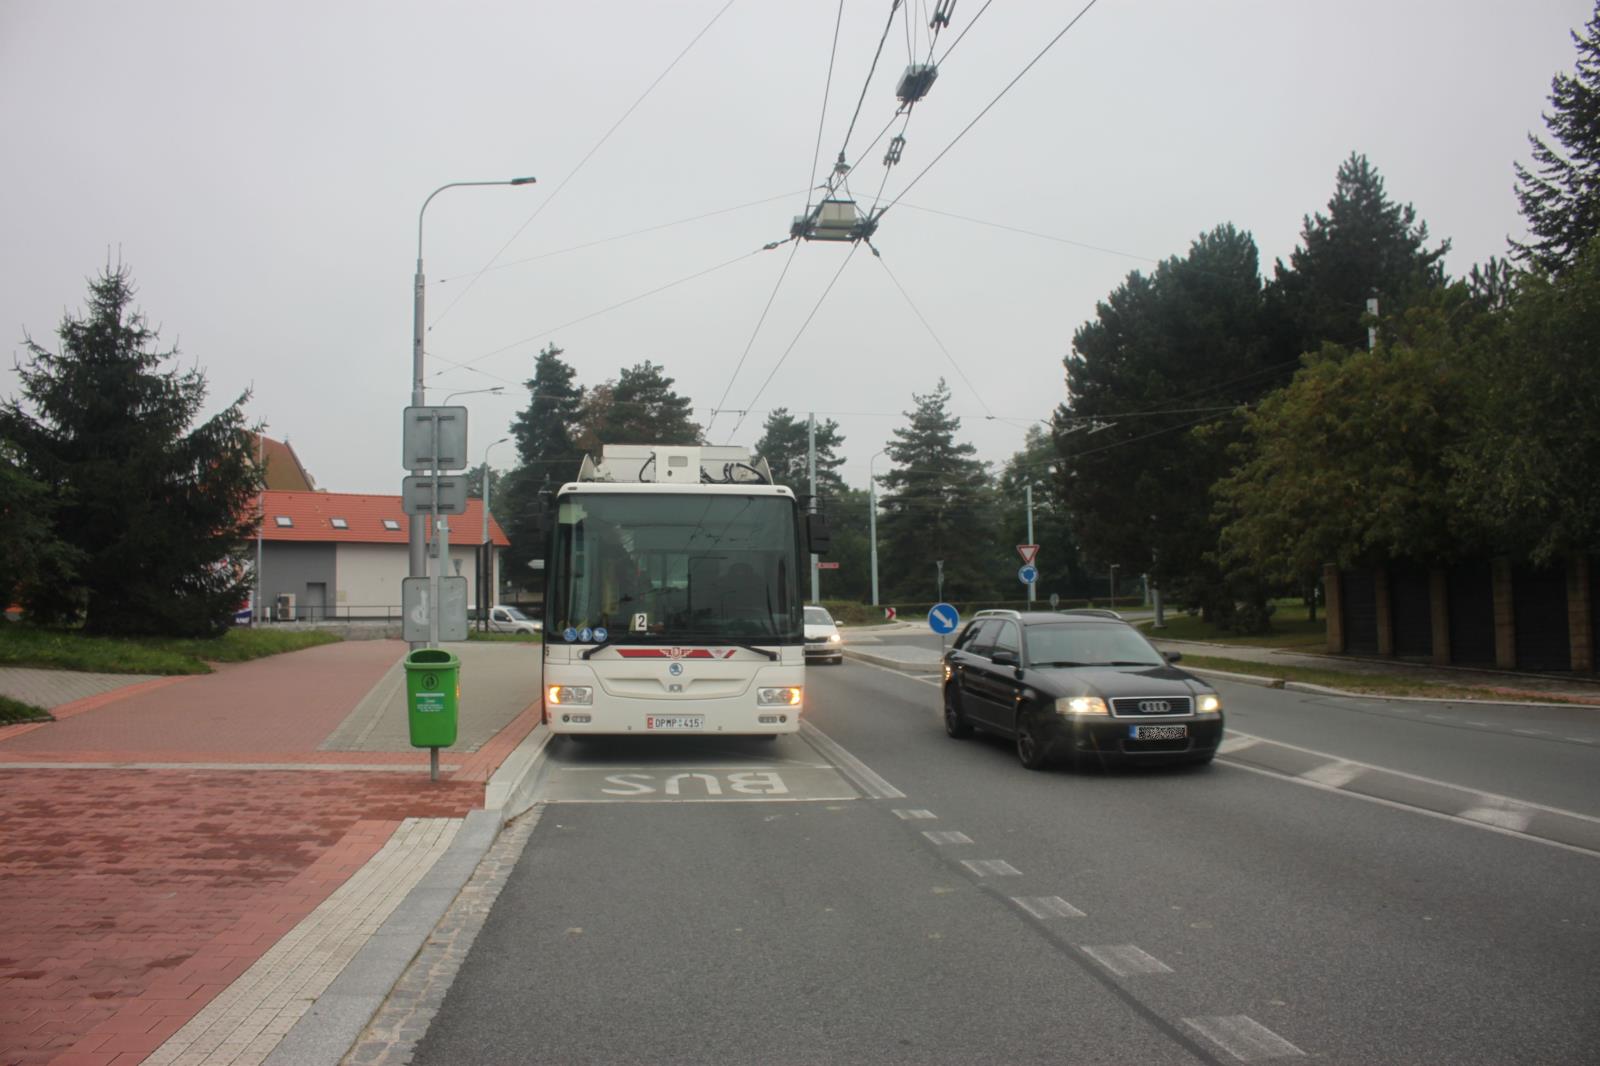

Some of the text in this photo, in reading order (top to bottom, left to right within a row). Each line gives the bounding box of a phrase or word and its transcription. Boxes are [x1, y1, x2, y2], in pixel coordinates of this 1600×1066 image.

[638, 615, 646, 628] 2
[655, 718, 700, 728] DPMP 415
[601, 772, 789, 796] BUS
